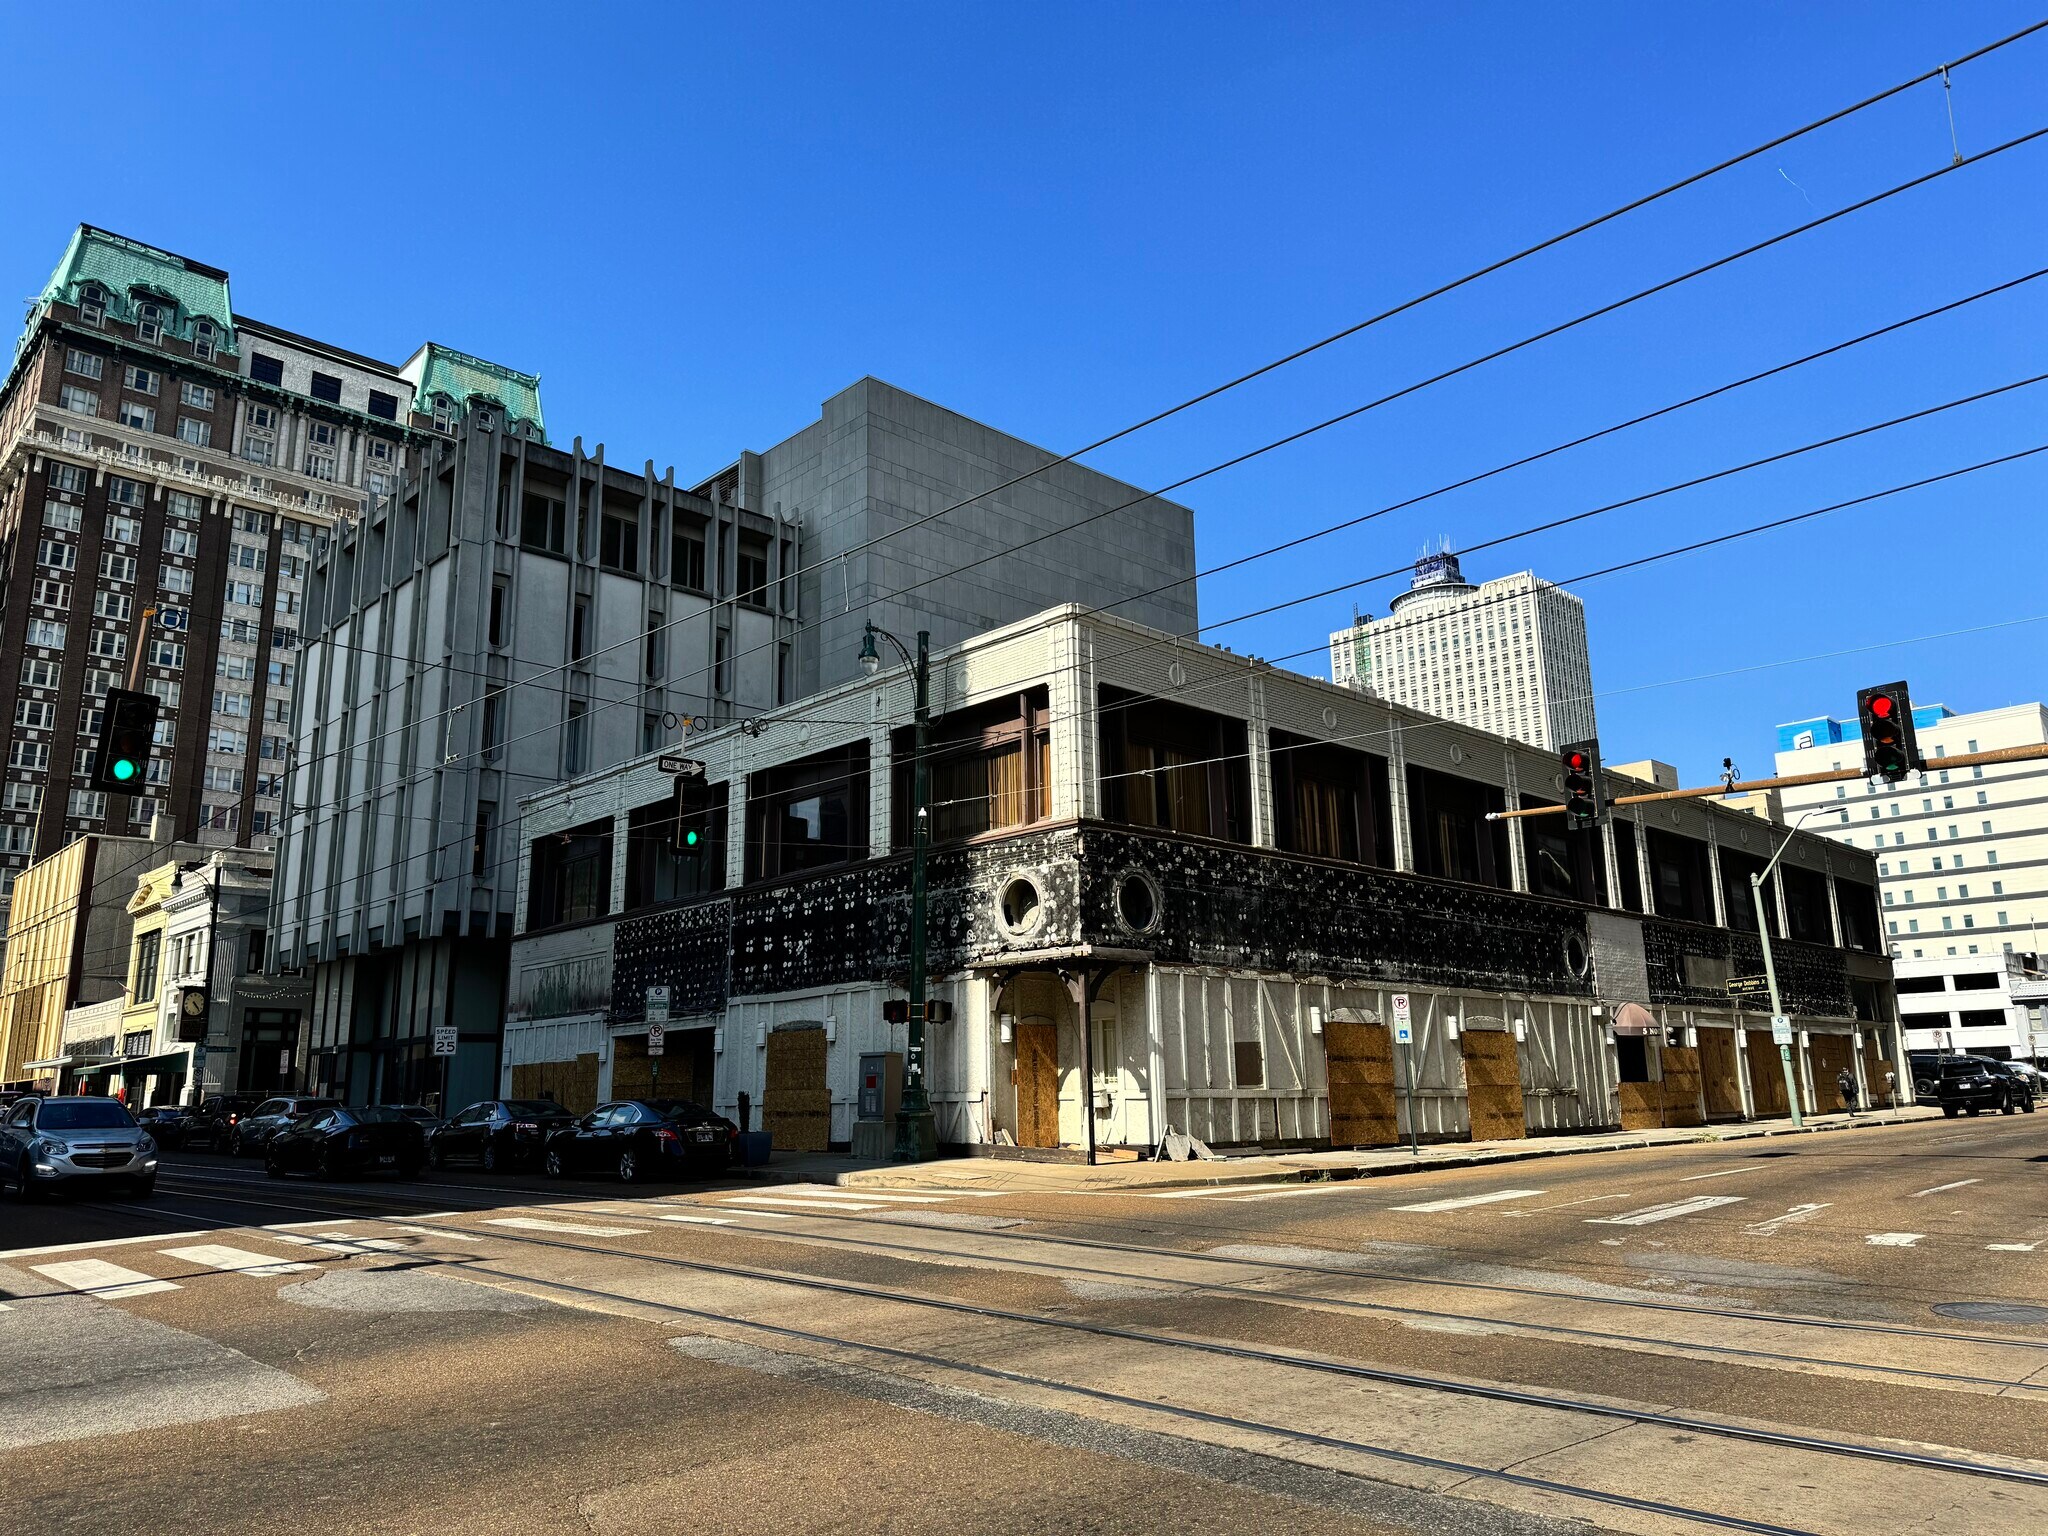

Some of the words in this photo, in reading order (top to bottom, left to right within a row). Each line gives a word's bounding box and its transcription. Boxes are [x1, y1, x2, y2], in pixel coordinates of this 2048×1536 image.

[664, 760, 677, 769] ONE
[679, 763, 693, 771] WAY
[1642, 1027, 1648, 1035] 5
[436, 1041, 455, 1052] 25
